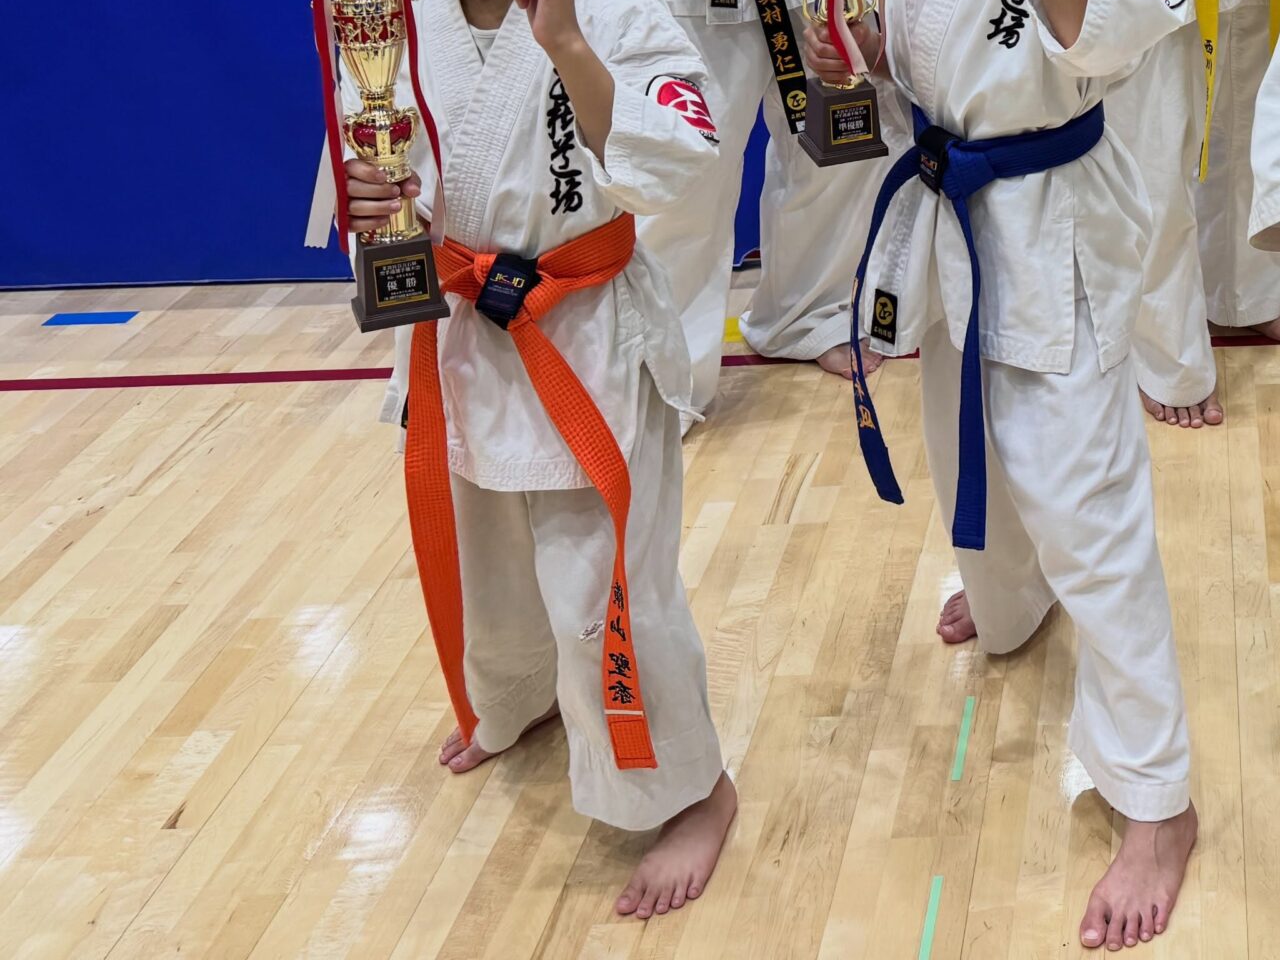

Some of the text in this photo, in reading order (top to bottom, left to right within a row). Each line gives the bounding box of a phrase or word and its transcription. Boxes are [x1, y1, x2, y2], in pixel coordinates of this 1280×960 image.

[770, 31, 796, 73] 勇仁
[838, 119, 864, 131] 準優勝
[387, 276, 417, 292] 優勝
